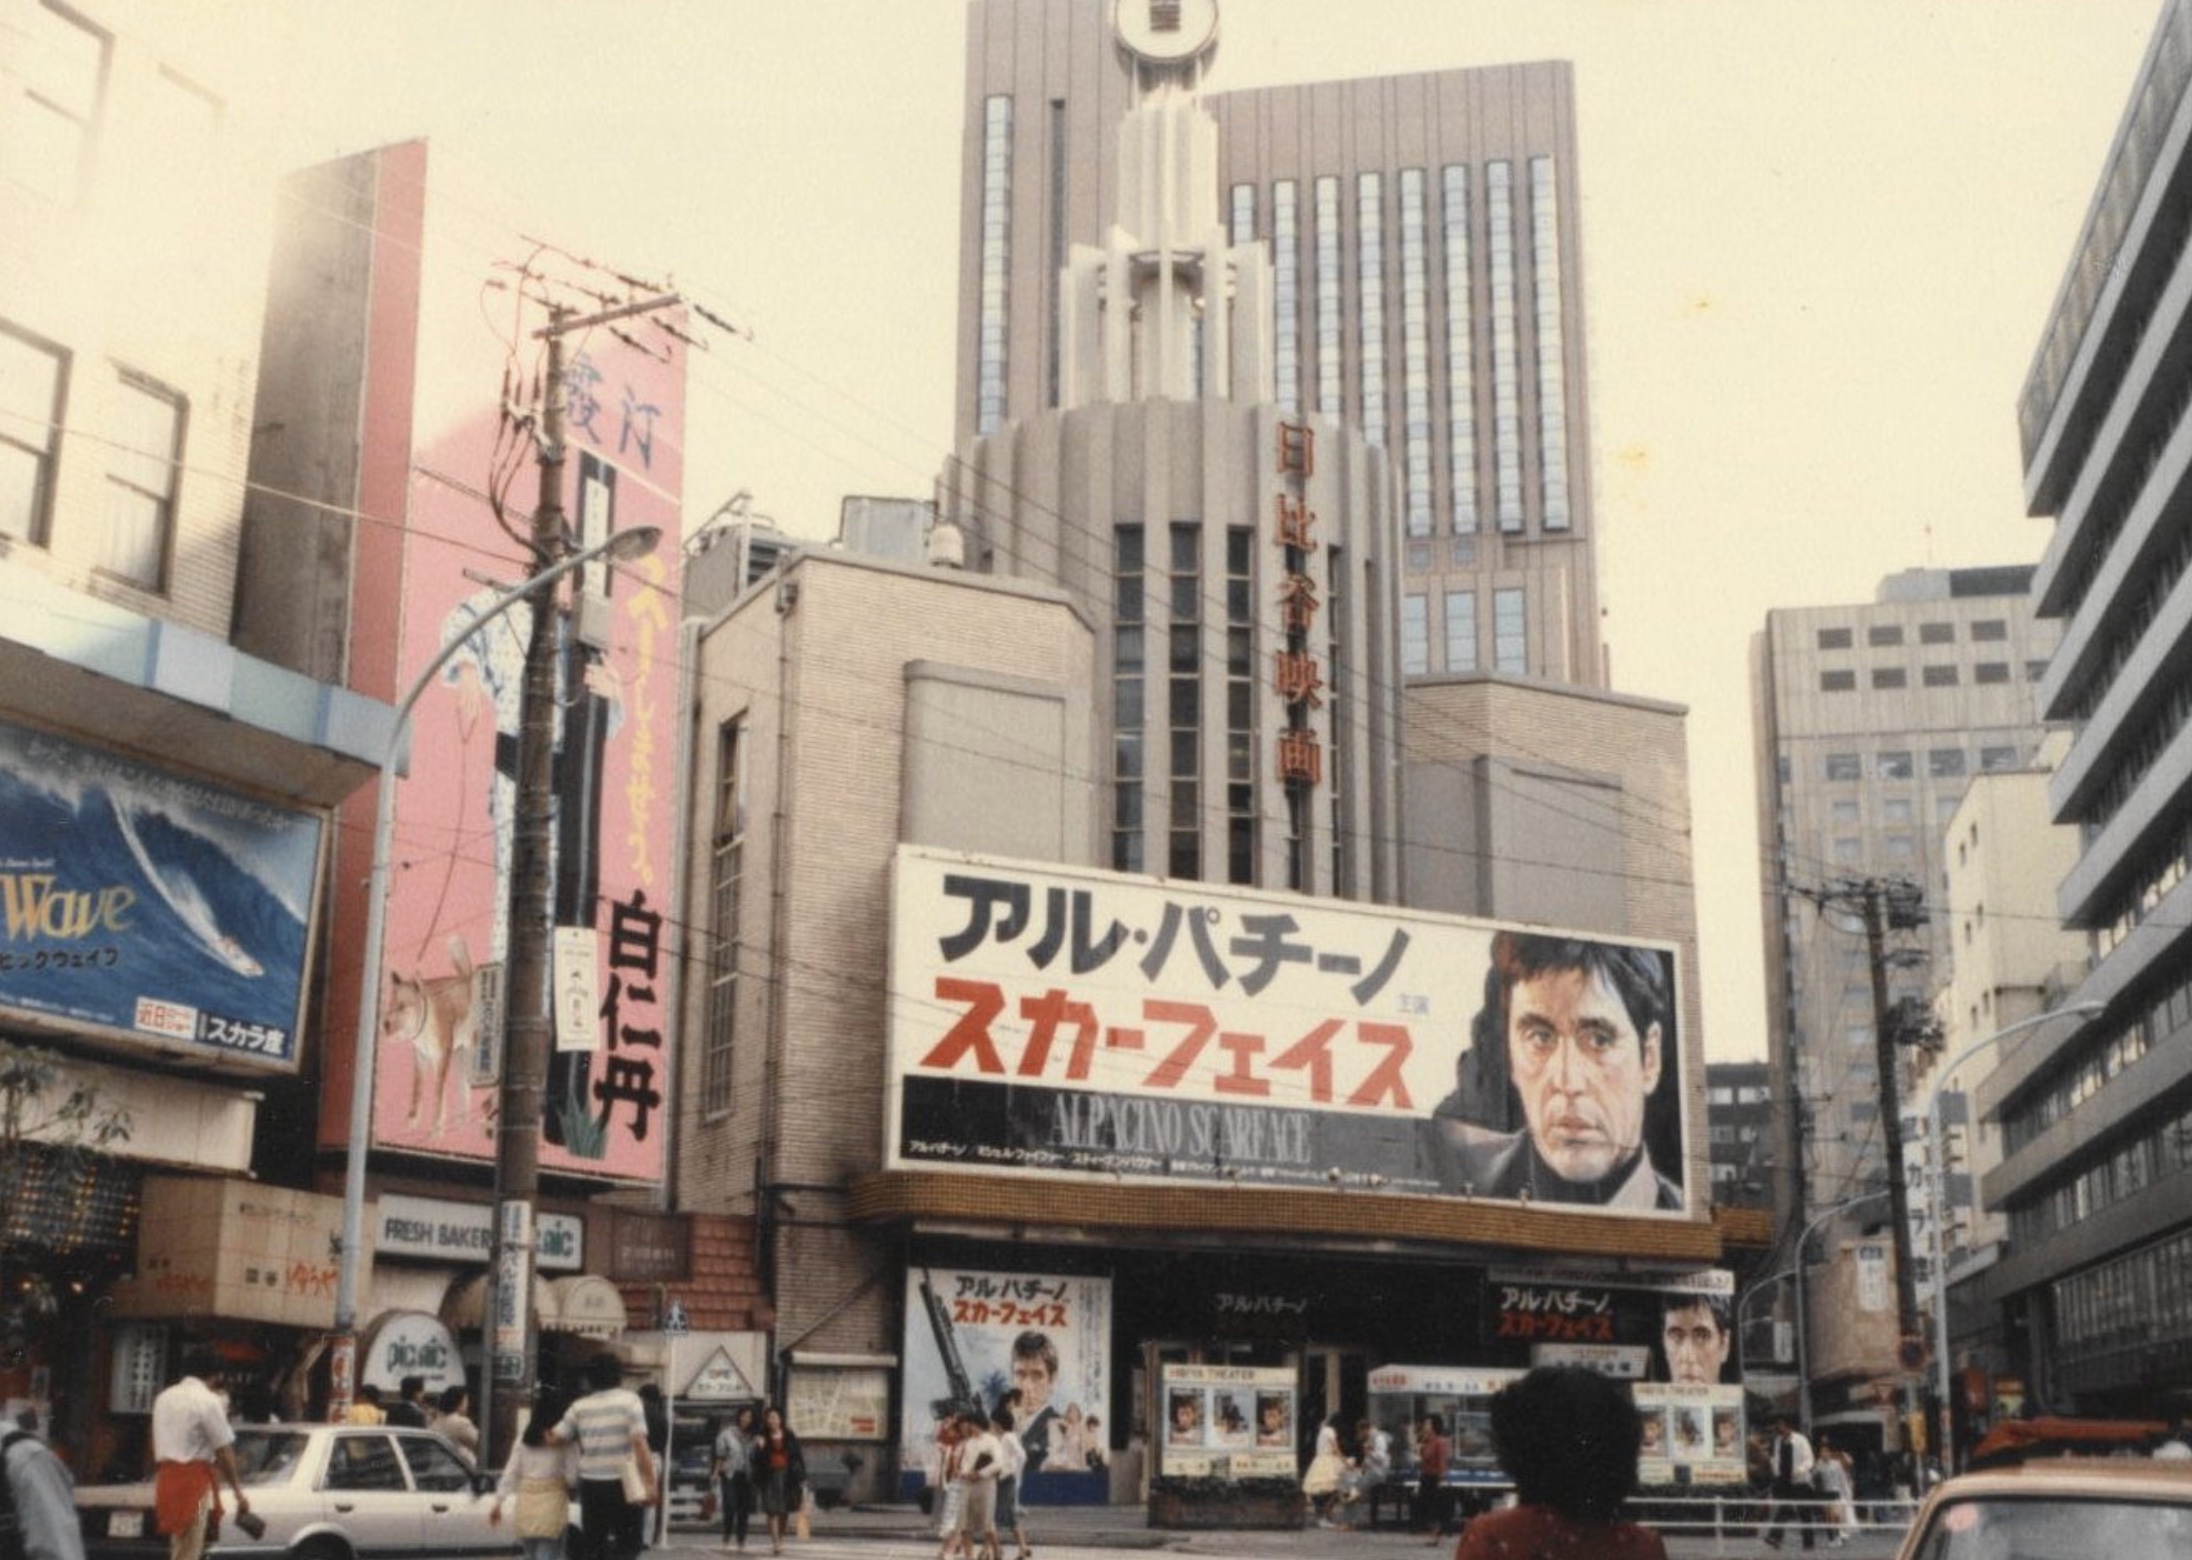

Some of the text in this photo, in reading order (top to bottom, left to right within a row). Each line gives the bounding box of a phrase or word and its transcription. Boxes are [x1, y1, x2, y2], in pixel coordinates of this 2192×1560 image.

[1274, 421, 1323, 787] 日比谷映画
[939, 874, 1411, 1007] アル・パチーノ
[208, 1017, 285, 1054] スカラ座
[918, 977, 1414, 1109] スカーフェイス
[1189, 1104, 1311, 1163] SCARFACE
[384, 1218, 495, 1250] FRESH BAKER
[953, 1301, 1068, 1327] スカーフェイス
